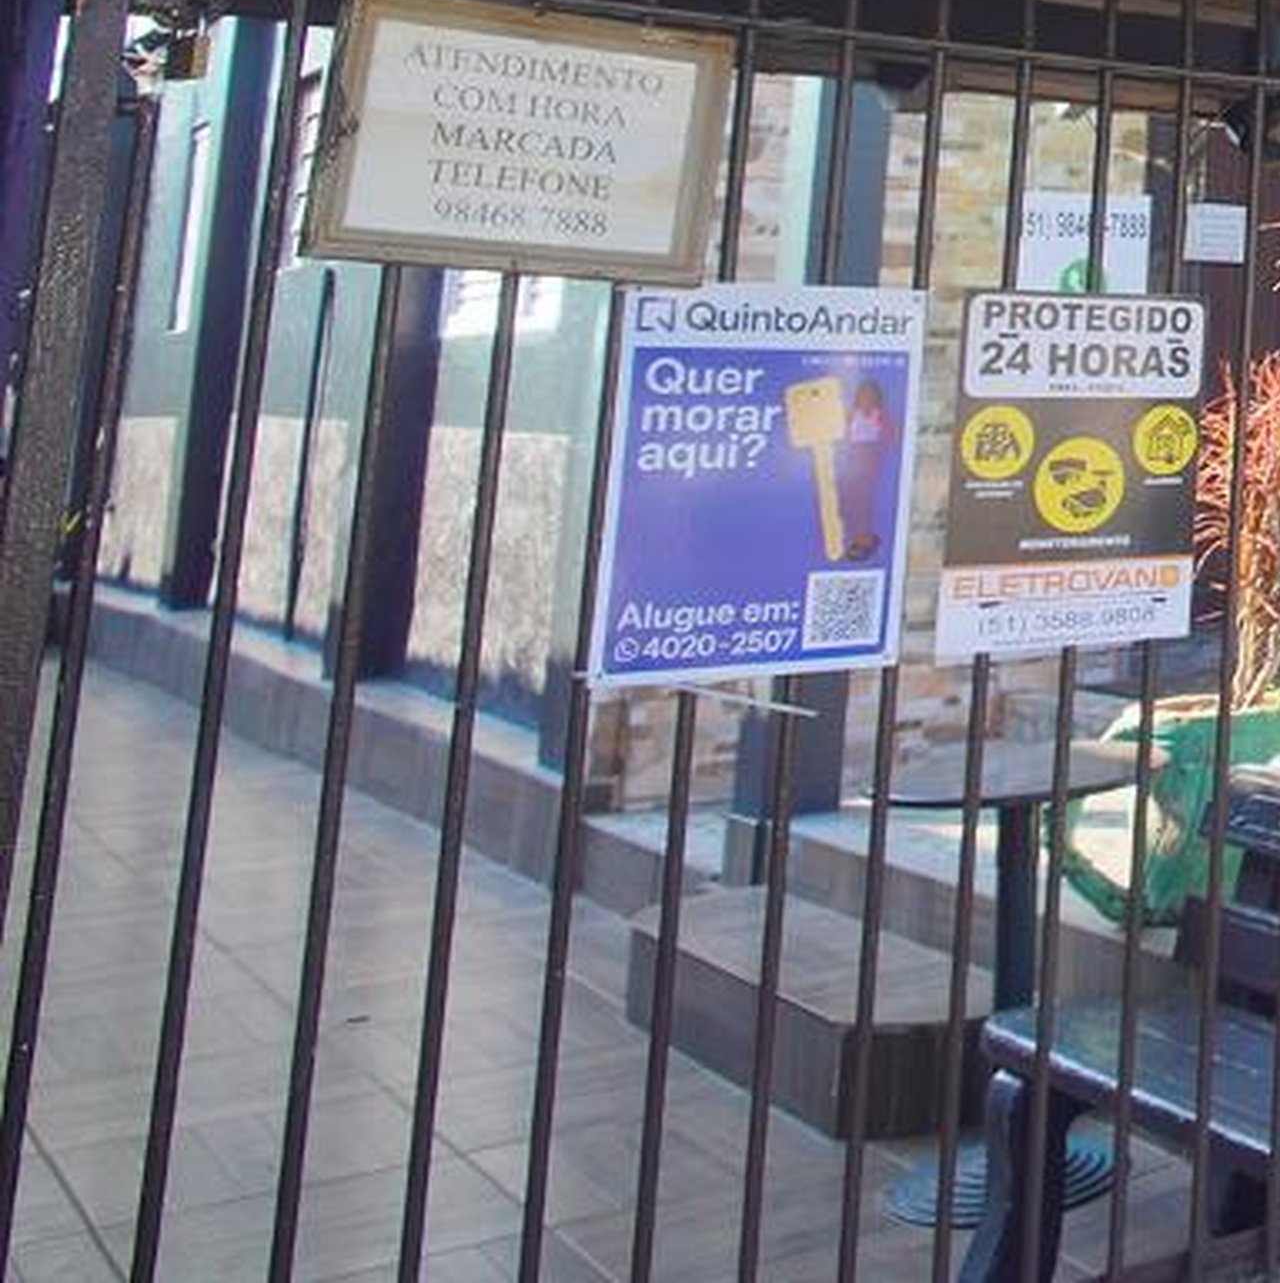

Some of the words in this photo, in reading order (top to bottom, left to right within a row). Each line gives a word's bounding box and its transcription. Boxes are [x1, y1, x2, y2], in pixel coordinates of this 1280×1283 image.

[404, 42, 665, 97] ATENDIMENTO
[433, 83, 517, 116] COM
[528, 98, 627, 128] HORA
[430, 121, 617, 164] MARCADA
[427, 158, 612, 199] TELEFONE
[686, 301, 913, 336] QuintoAndar
[983, 300, 1193, 334] PROTEGIDO
[644, 356, 764, 396] Quer
[979, 341, 1033, 376] 24
[1048, 342, 1191, 379] HORAS
[639, 400, 781, 434] morar
[637, 433, 767, 477] aqui?
[617, 602, 736, 634] Alugue
[742, 601, 800, 625] em:
[641, 629, 798, 659] 4020-2507
